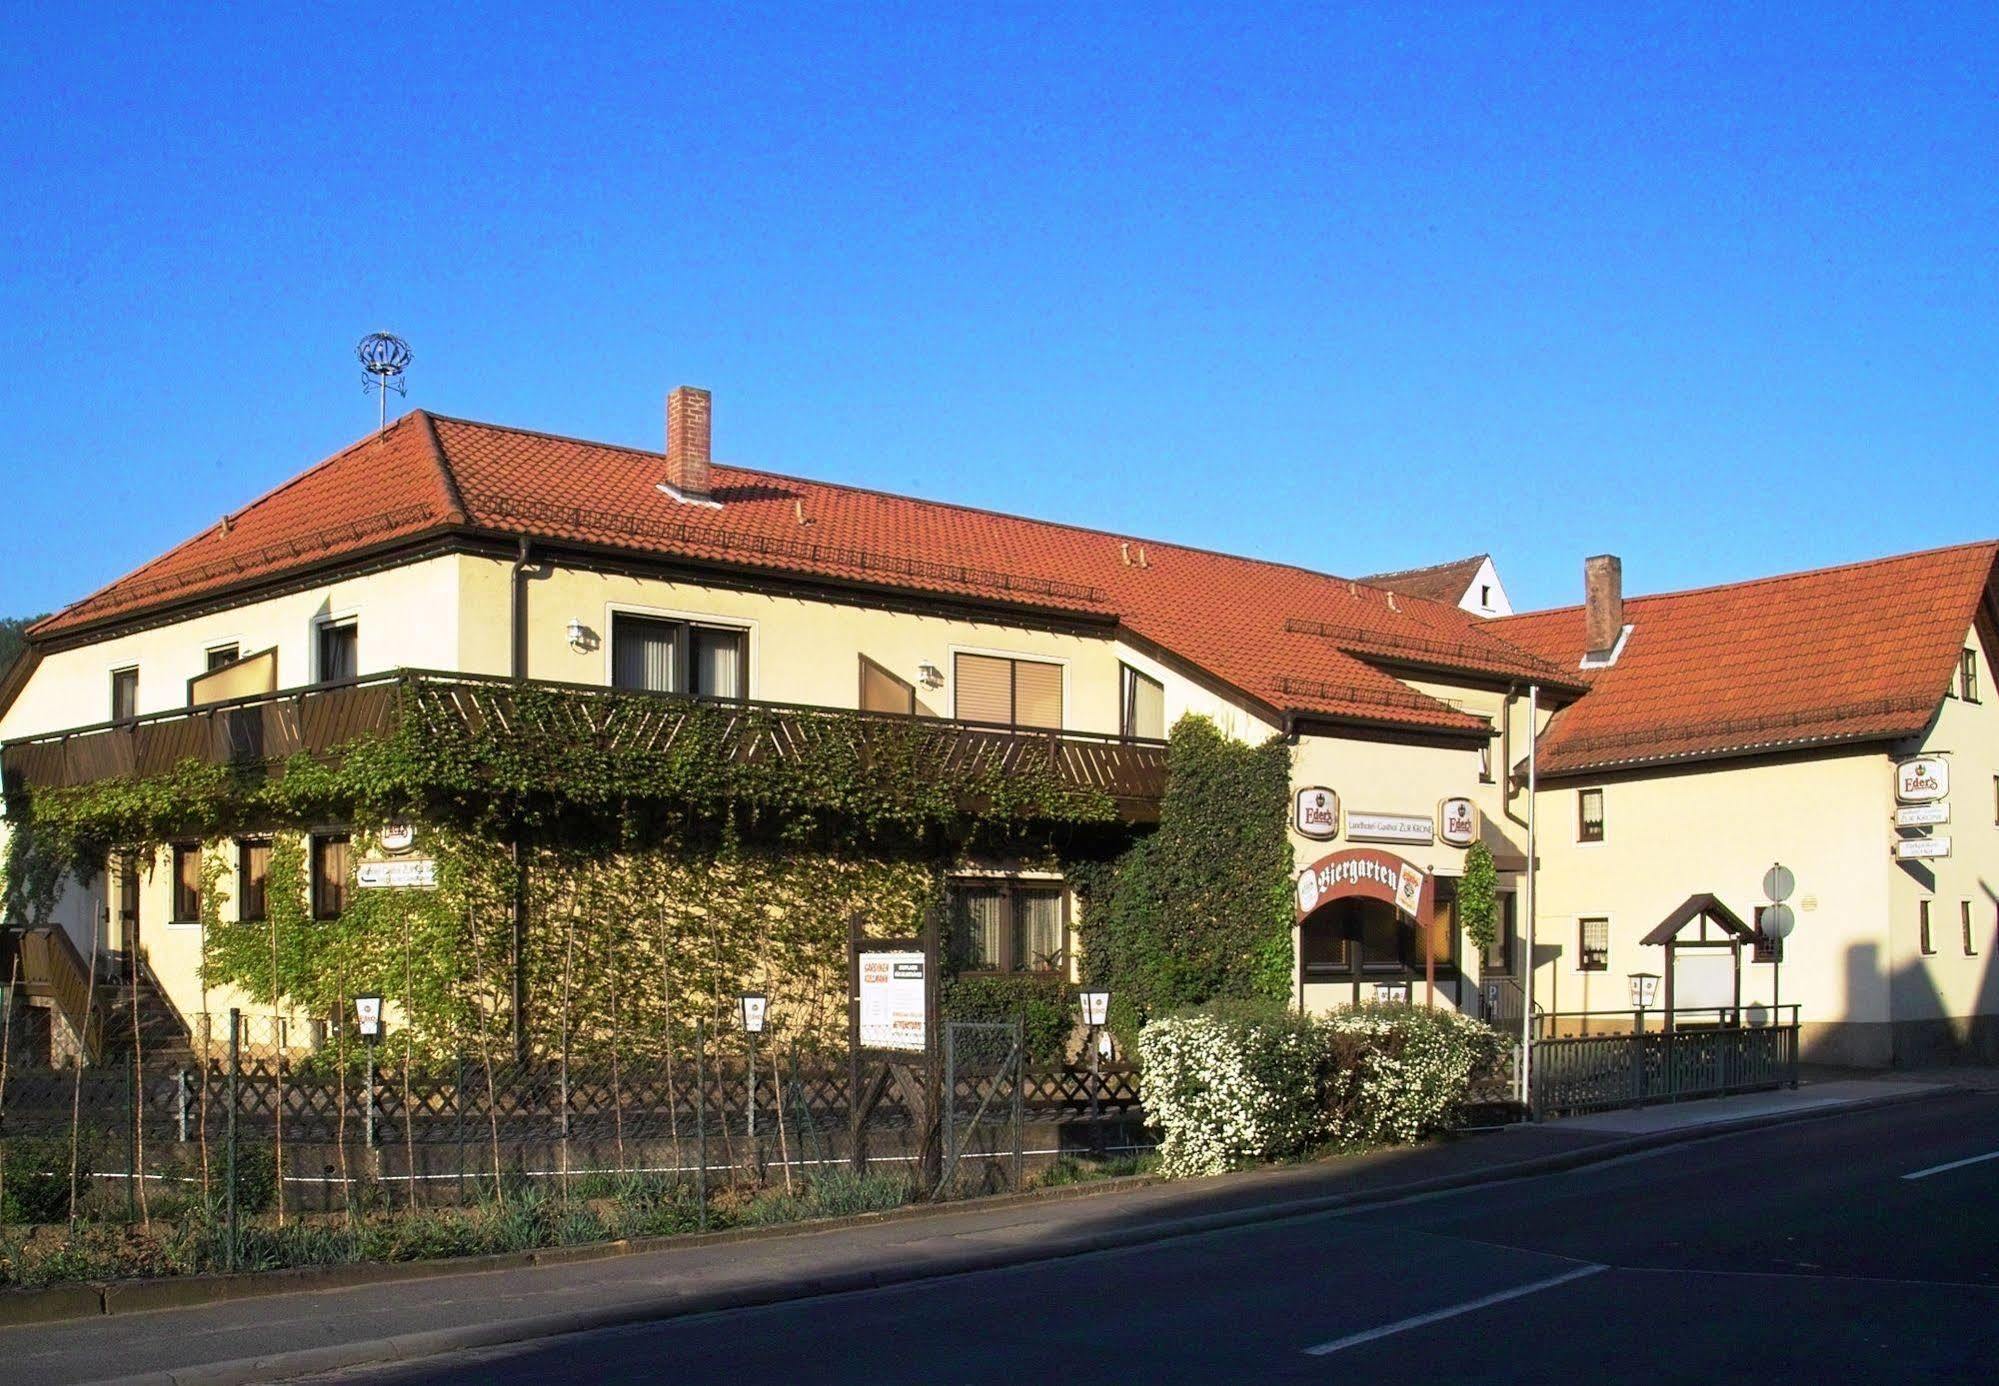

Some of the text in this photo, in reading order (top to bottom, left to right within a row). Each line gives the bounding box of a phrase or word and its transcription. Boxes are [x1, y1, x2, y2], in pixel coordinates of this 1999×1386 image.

[1904, 776, 1938, 792] Eder's
[1305, 807, 1333, 826] Eder's
[1448, 817, 1472, 834] Eder's
[1317, 859, 1397, 894] Biergarten
